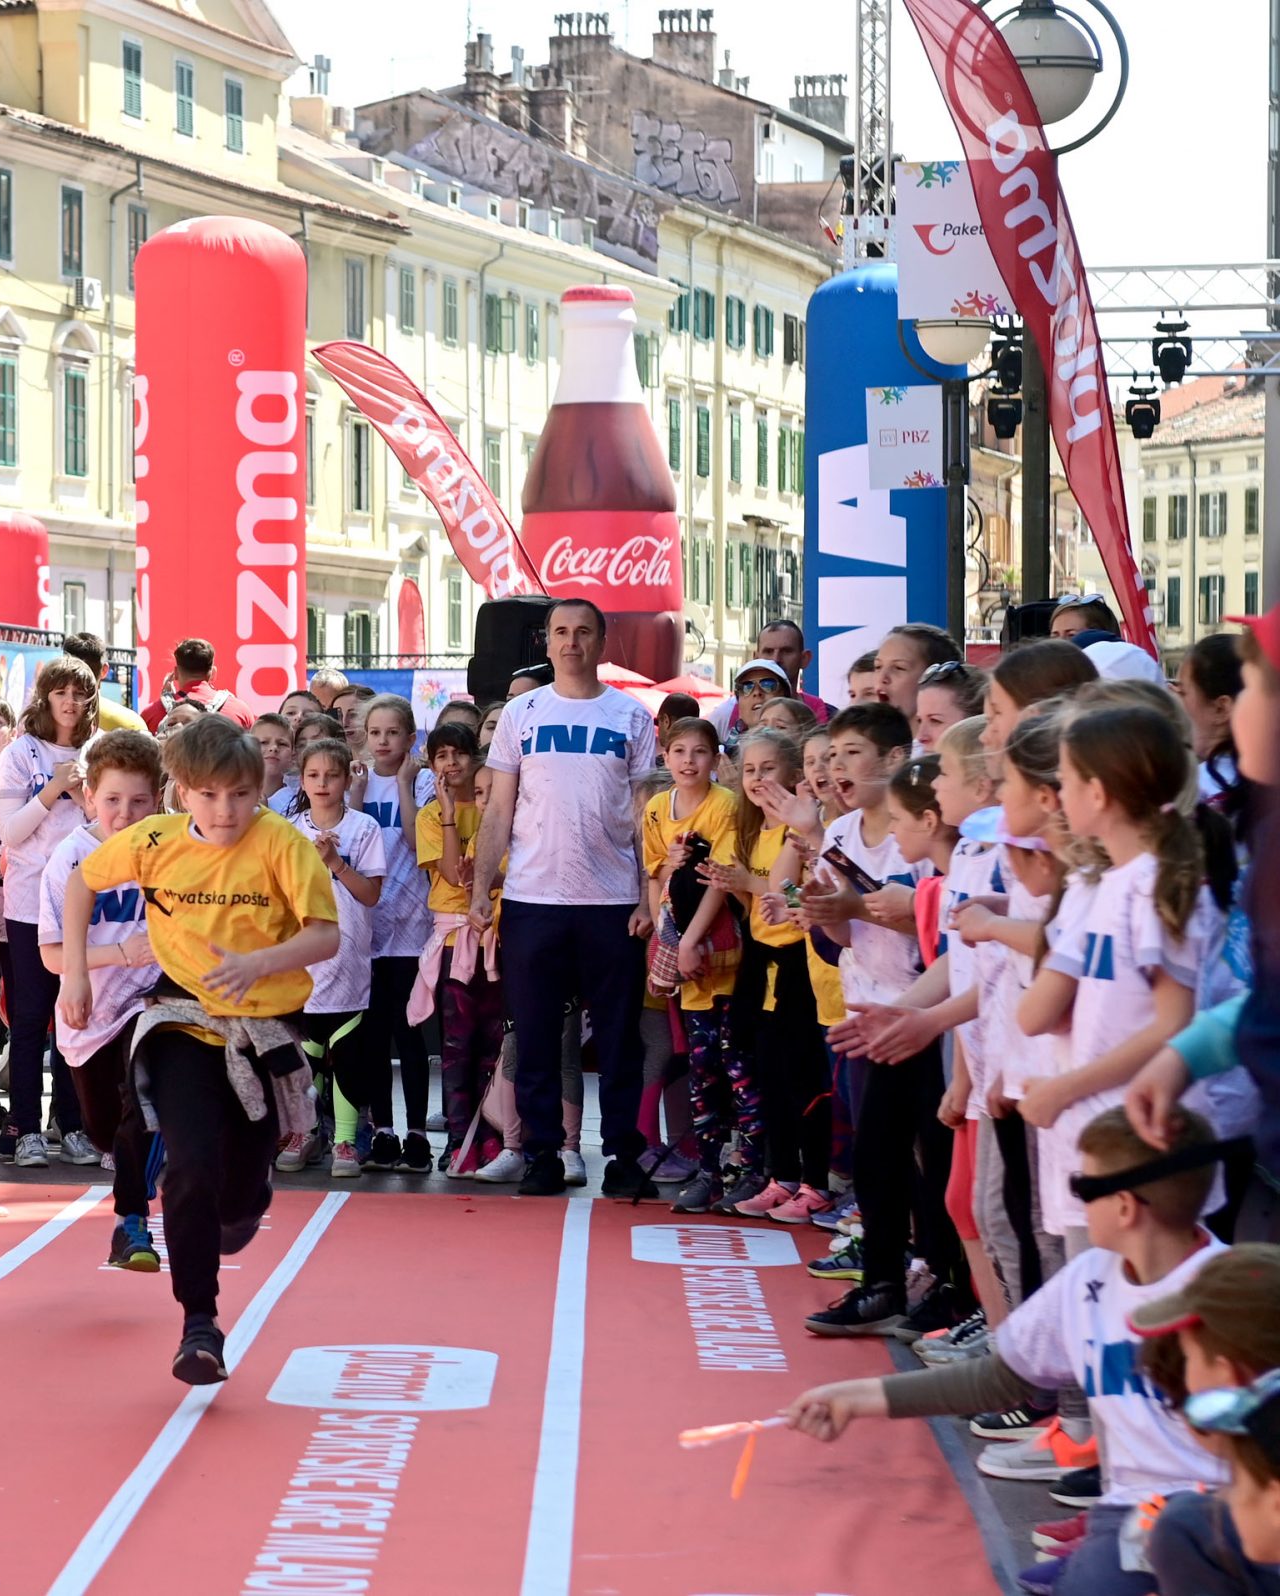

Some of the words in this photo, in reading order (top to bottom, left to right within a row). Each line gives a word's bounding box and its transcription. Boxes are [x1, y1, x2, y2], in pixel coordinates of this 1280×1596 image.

[901, 430, 931, 445] PBZ
[540, 535, 673, 587] Coca-Cola
[163, 888, 227, 905] Hrvatska
[230, 891, 270, 907] pošta
[680, 1267, 767, 1309] SPORTSKE
[687, 1308, 776, 1331] IGRE
[693, 1330, 790, 1372] MLADIH
[321, 1350, 462, 1402] plazma
[288, 1413, 421, 1490] SPORTSKE
[270, 1490, 397, 1532] IGRE
